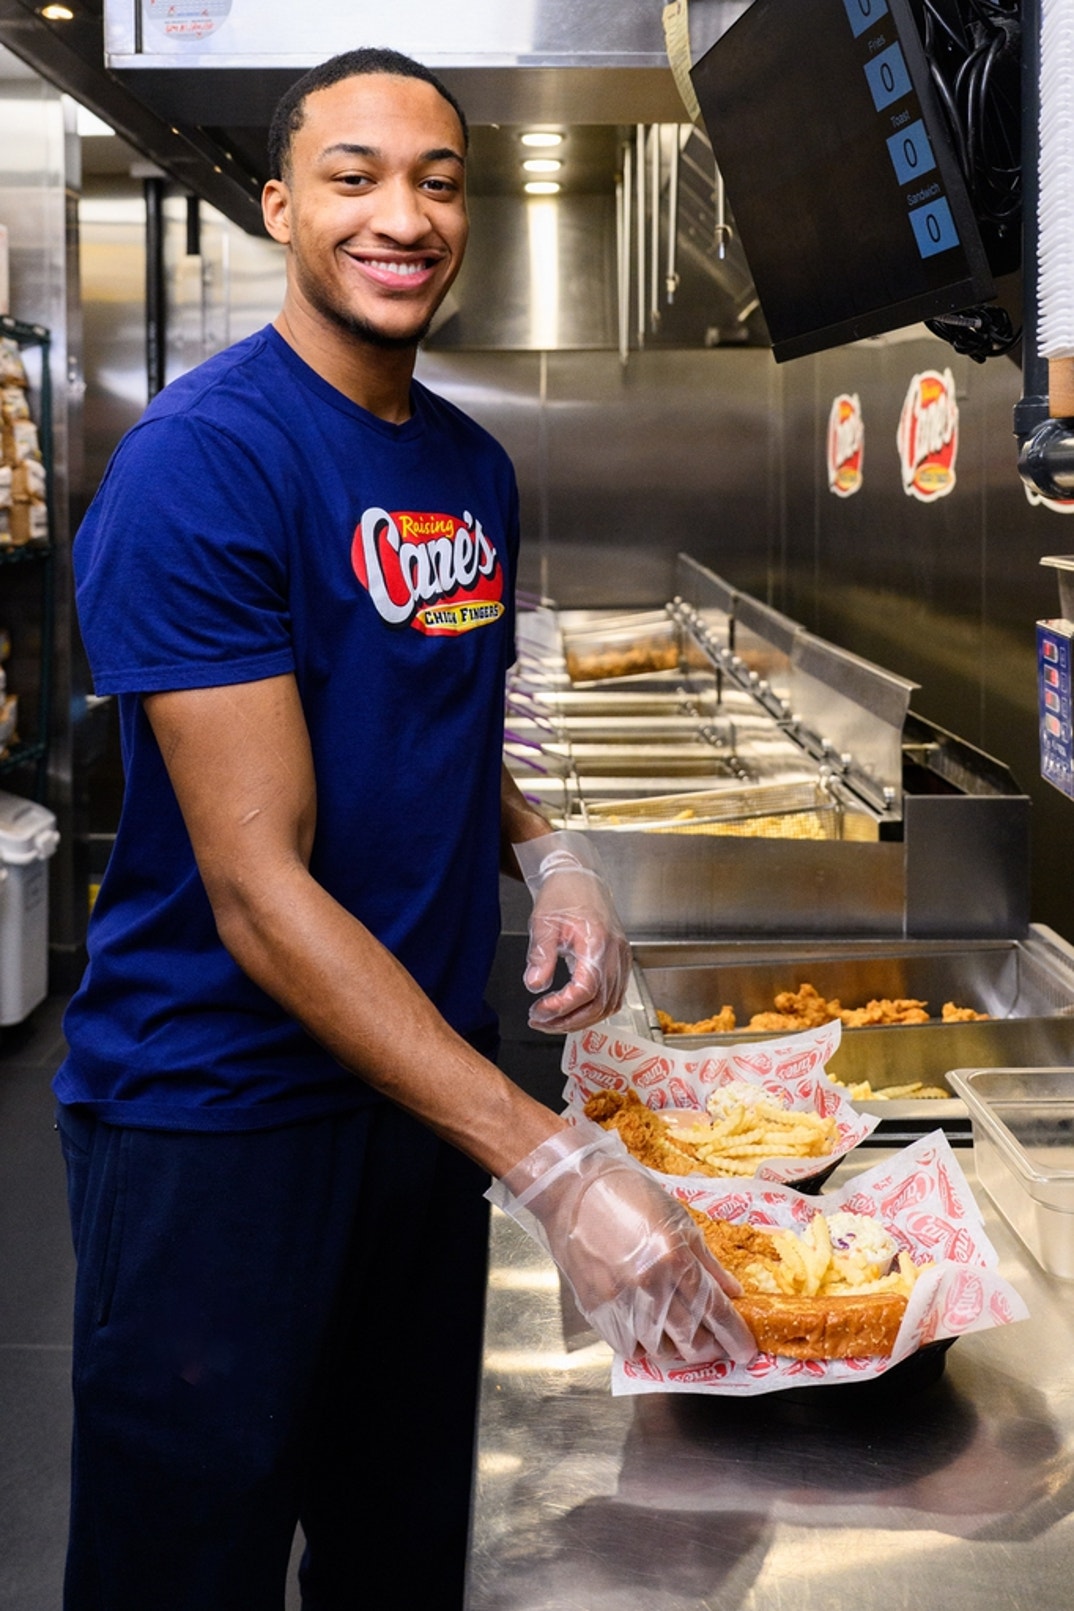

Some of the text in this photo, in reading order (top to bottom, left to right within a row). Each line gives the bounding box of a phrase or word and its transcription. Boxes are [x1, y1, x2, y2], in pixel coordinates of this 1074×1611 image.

[868, 34, 885, 52] Fries
[881, 62, 895, 92] 0
[890, 110, 910, 128] Toast
[903, 138, 918, 168] 0
[907, 183, 941, 206] Sandwich
[926, 213, 941, 243] 0
[399, 515, 455, 539] Raising
[361, 507, 497, 624] Cane's
[459, 603, 499, 622] FINGERS
